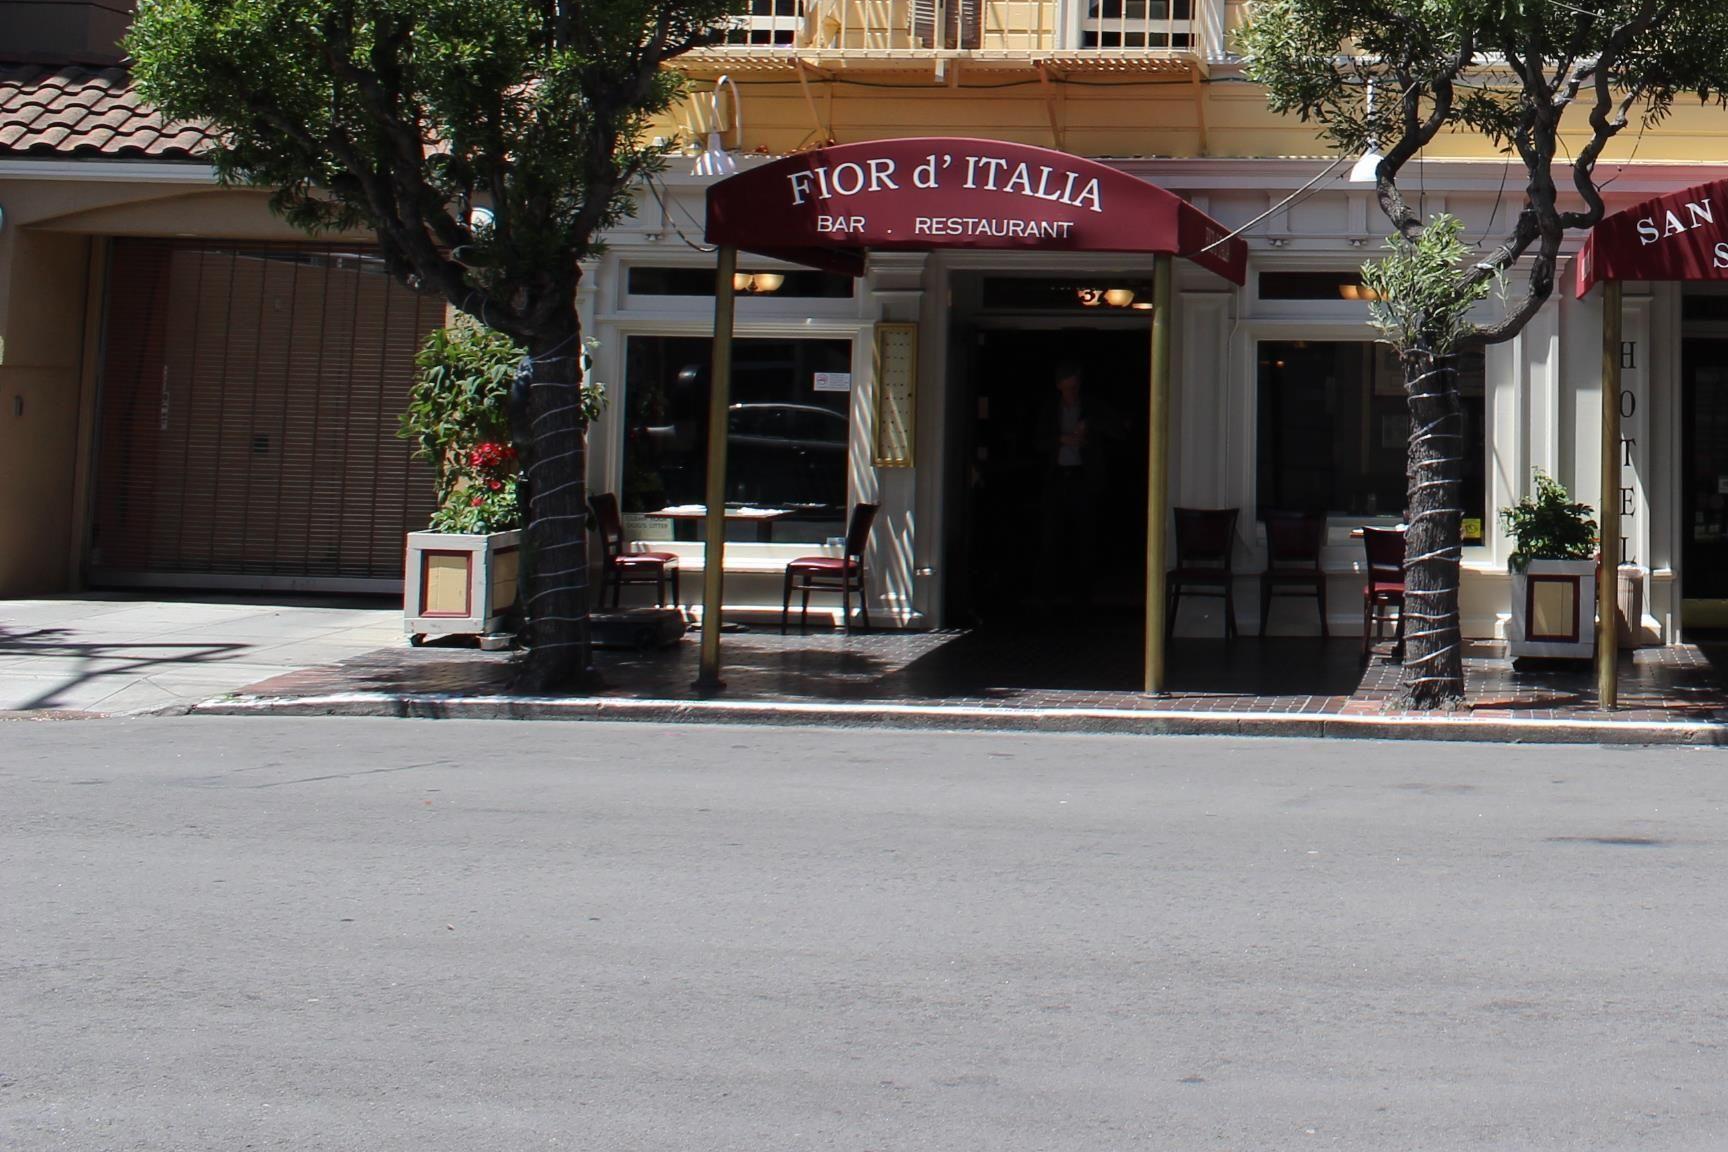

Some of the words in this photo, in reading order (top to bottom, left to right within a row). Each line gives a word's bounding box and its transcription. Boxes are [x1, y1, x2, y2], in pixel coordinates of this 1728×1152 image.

[786, 157, 899, 206] FIOR
[816, 215, 866, 235] BAR
[914, 216, 1074, 240] RESTAURANT
[1637, 198, 1714, 247] SAN
